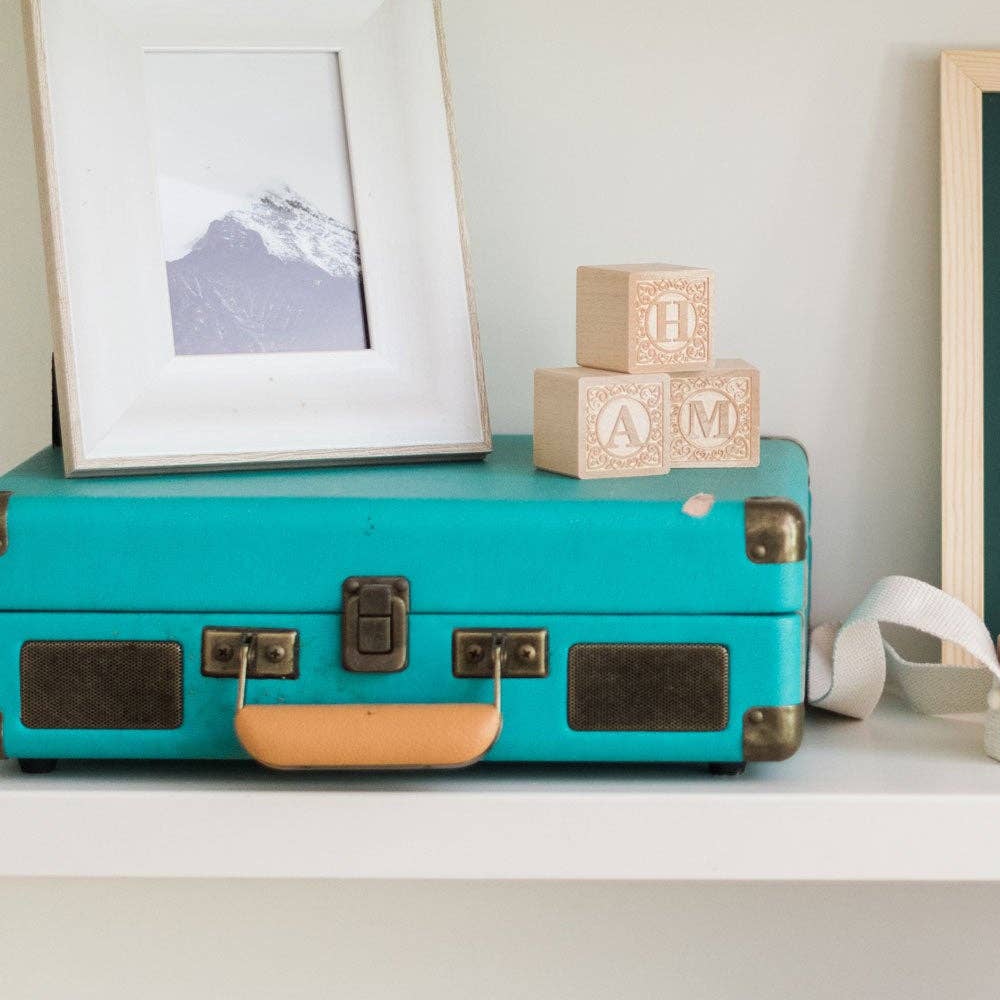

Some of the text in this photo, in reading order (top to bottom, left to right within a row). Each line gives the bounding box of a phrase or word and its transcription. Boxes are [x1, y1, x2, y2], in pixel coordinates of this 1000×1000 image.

[652, 301, 690, 343] H
[602, 405, 648, 448] A
[685, 400, 732, 440] M
